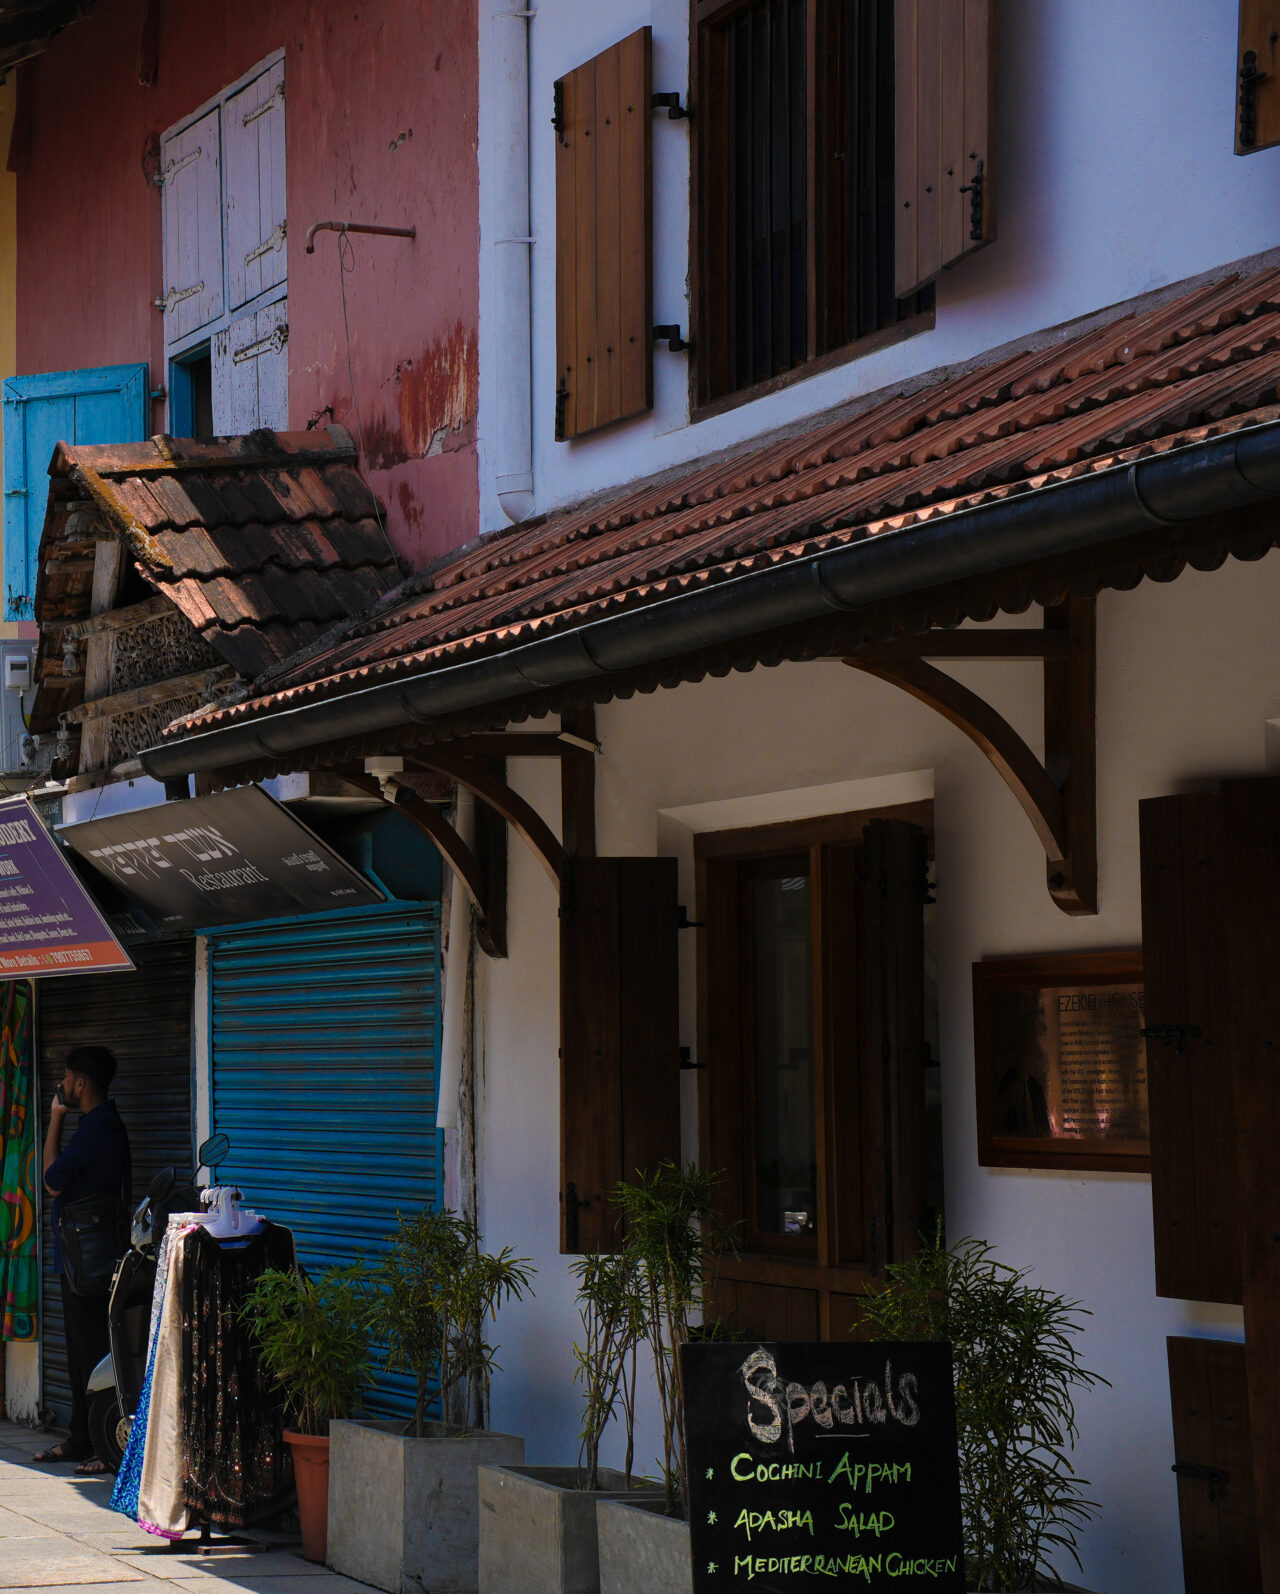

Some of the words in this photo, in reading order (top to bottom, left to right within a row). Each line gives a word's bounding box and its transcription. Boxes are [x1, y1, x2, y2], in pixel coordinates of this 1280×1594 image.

[179, 859, 269, 892] Restaurant
[0, 956, 18, 968] More
[17, 954, 38, 966] Details
[1057, 994, 1100, 1012] EZEKIEL
[1104, 991, 1144, 1010] HOUSE
[738, 1345, 921, 1455] Specials
[827, 1451, 912, 1494] APPAM
[734, 1507, 815, 1542] ADASHA
[834, 1502, 895, 1538] SALAD
[733, 1553, 883, 1583] MEDITERRANEAN
[885, 1551, 958, 1578] CHICKEN
